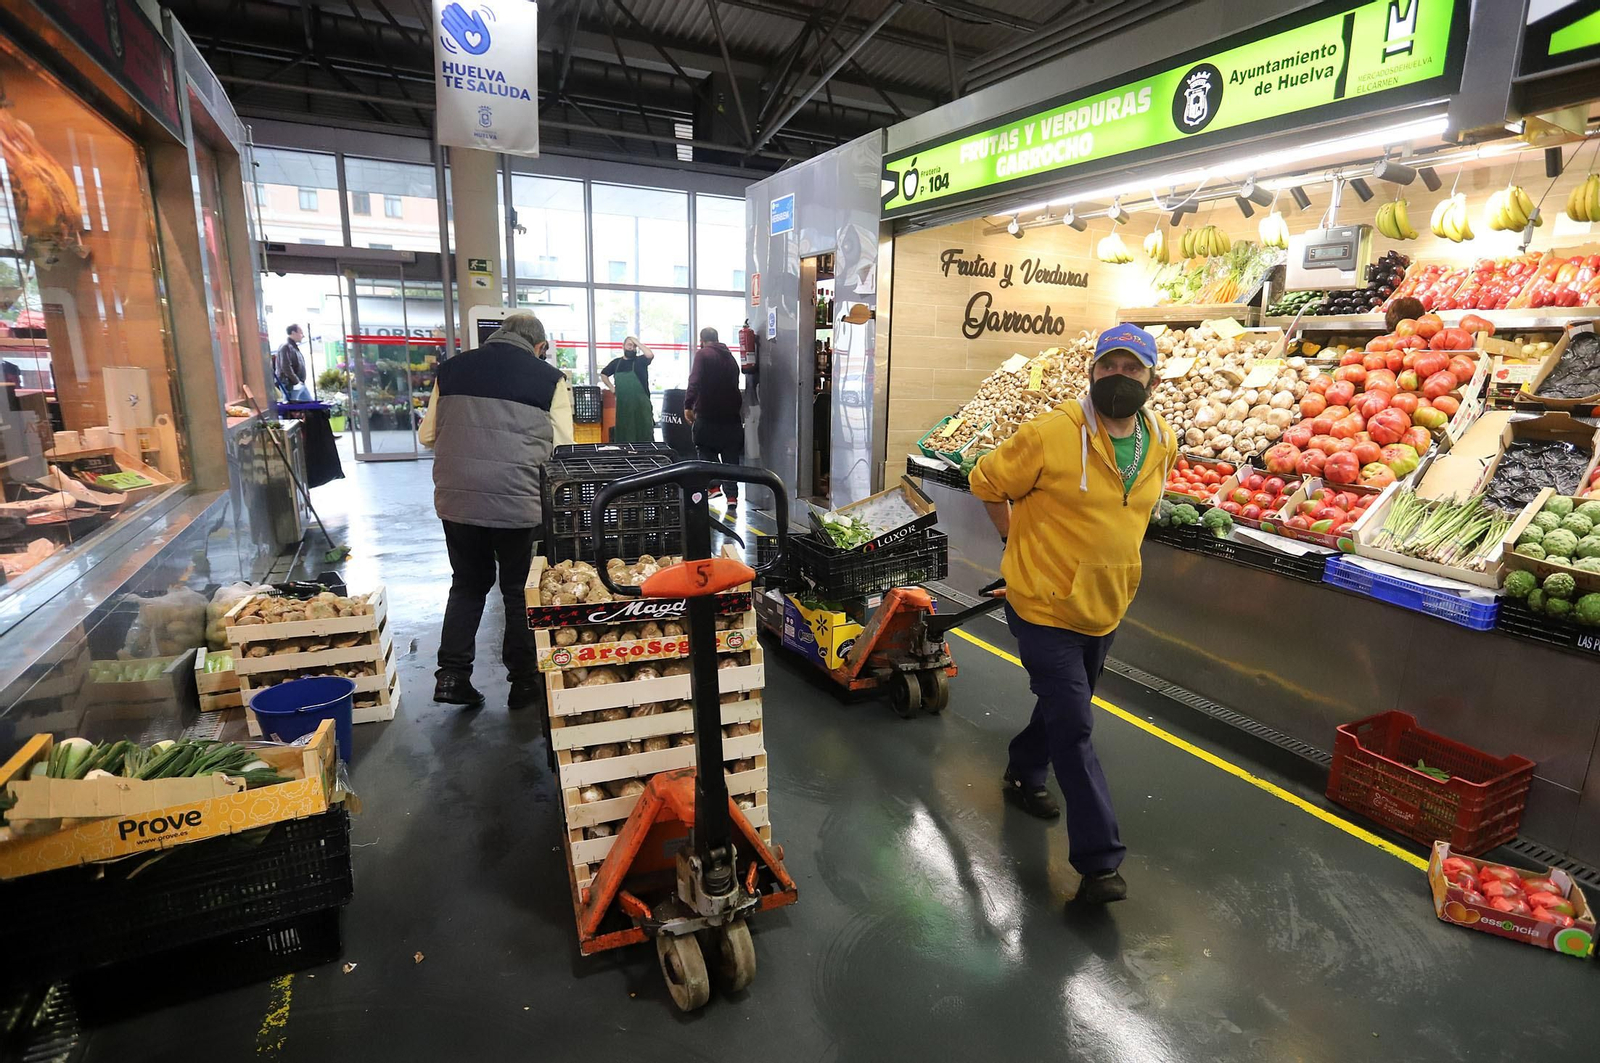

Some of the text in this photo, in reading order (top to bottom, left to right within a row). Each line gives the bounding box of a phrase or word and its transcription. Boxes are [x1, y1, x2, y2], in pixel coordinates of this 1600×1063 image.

[441, 61, 506, 84] HUELVA
[1229, 41, 1338, 85] Ayuntamiento
[443, 75, 531, 102] TE SALUDA
[1253, 66, 1335, 97] de Huelva
[960, 86, 1153, 165] FRUTAS Y VERDURAS
[996, 133, 1095, 178] GARROCHO
[929, 172, 950, 193] 104
[940, 248, 1089, 288] Frutas y Verduras
[962, 291, 1066, 340] Garrocho
[877, 524, 917, 548] LUXOR
[695, 566, 709, 587] 5
[588, 599, 687, 623] Magd
[1577, 634, 1593, 649] LAS
[118, 811, 202, 841] Prove
[136, 830, 189, 846] www.prove.es
[1480, 916, 1540, 938] essencia
